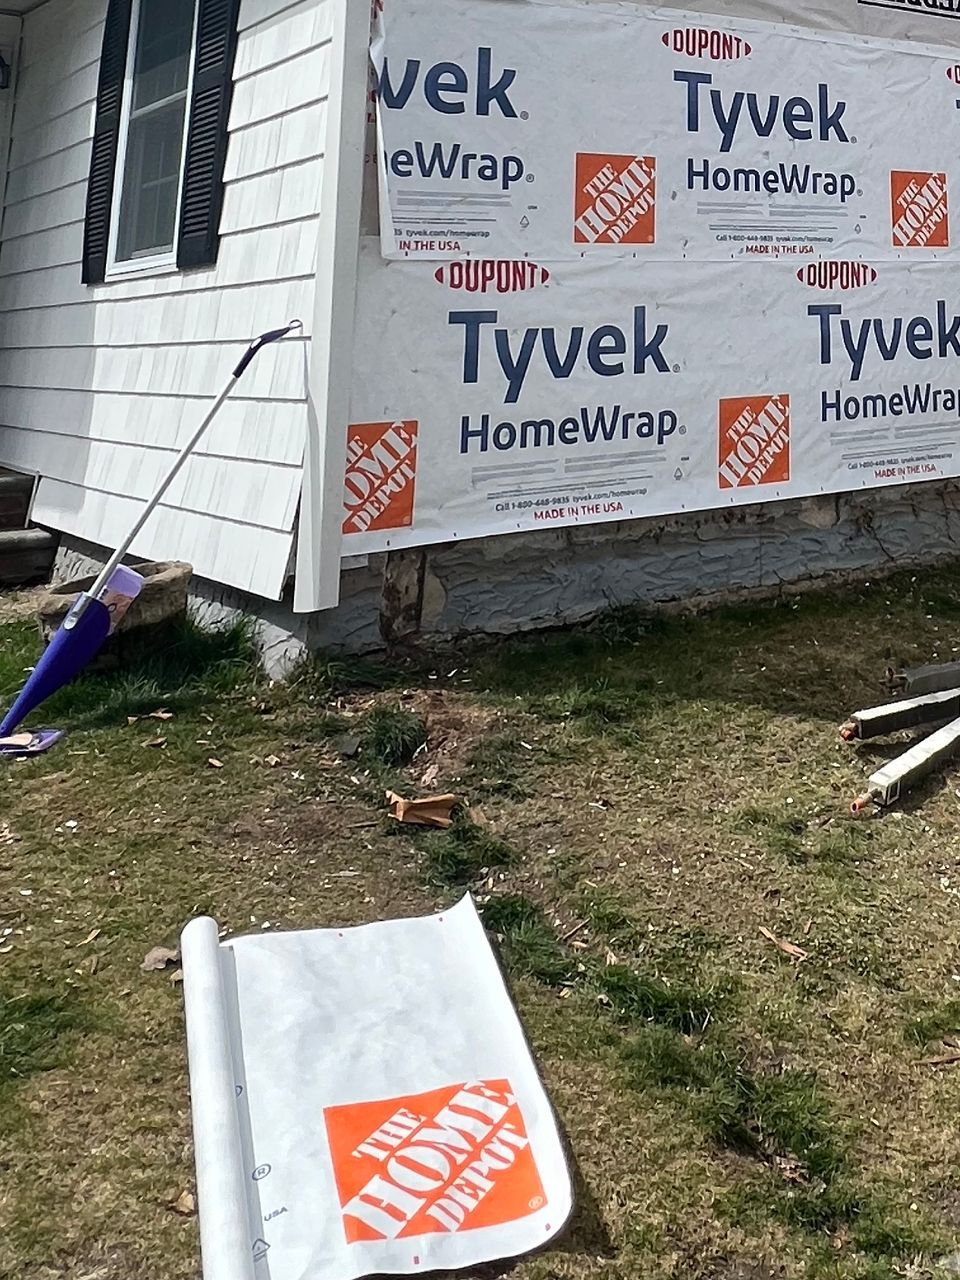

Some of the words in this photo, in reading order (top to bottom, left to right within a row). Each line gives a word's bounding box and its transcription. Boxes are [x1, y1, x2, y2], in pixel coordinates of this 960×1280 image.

[673, 28, 742, 60] DUPONT
[380, 47, 519, 119] vek
[673, 70, 849, 153] Tyvek
[384, 141, 524, 190] eWrap
[687, 158, 856, 202] HomeWrap
[575, 155, 656, 243] HOME
[607, 189, 656, 243] DEPOT
[892, 172, 948, 247] HOME
[915, 200, 948, 247] DEPOT
[399, 240, 411, 250] IN
[414, 240, 435, 251] THE
[438, 240, 461, 251] USA
[745, 245, 769, 253] MADE
[771, 245, 780, 253] IN
[781, 245, 797, 253] THE
[799, 245, 814, 254] USA
[450, 259, 538, 293] DUPONT
[807, 261, 868, 290] DUPONT
[448, 305, 670, 403] Tyvek
[460, 405, 677, 454] HomeWrap
[719, 395, 790, 488] HOME
[343, 422, 418, 516] OME
[747, 426, 790, 486] DEPOT
[874, 468, 896, 478] MADE
[907, 465, 920, 474] THE
[921, 463, 936, 473] USA
[351, 460, 417, 532] DEPOT
[495, 503, 510, 512] Call
[533, 508, 565, 520] MADE
[568, 507, 579, 516] IN
[582, 504, 601, 515] THE
[603, 501, 623, 512] USA
[342, 1080, 519, 1239] HOME
[352, 1108, 428, 1161] THE
[425, 1123, 529, 1232] DEPOT
[263, 1206, 288, 1222] USA
